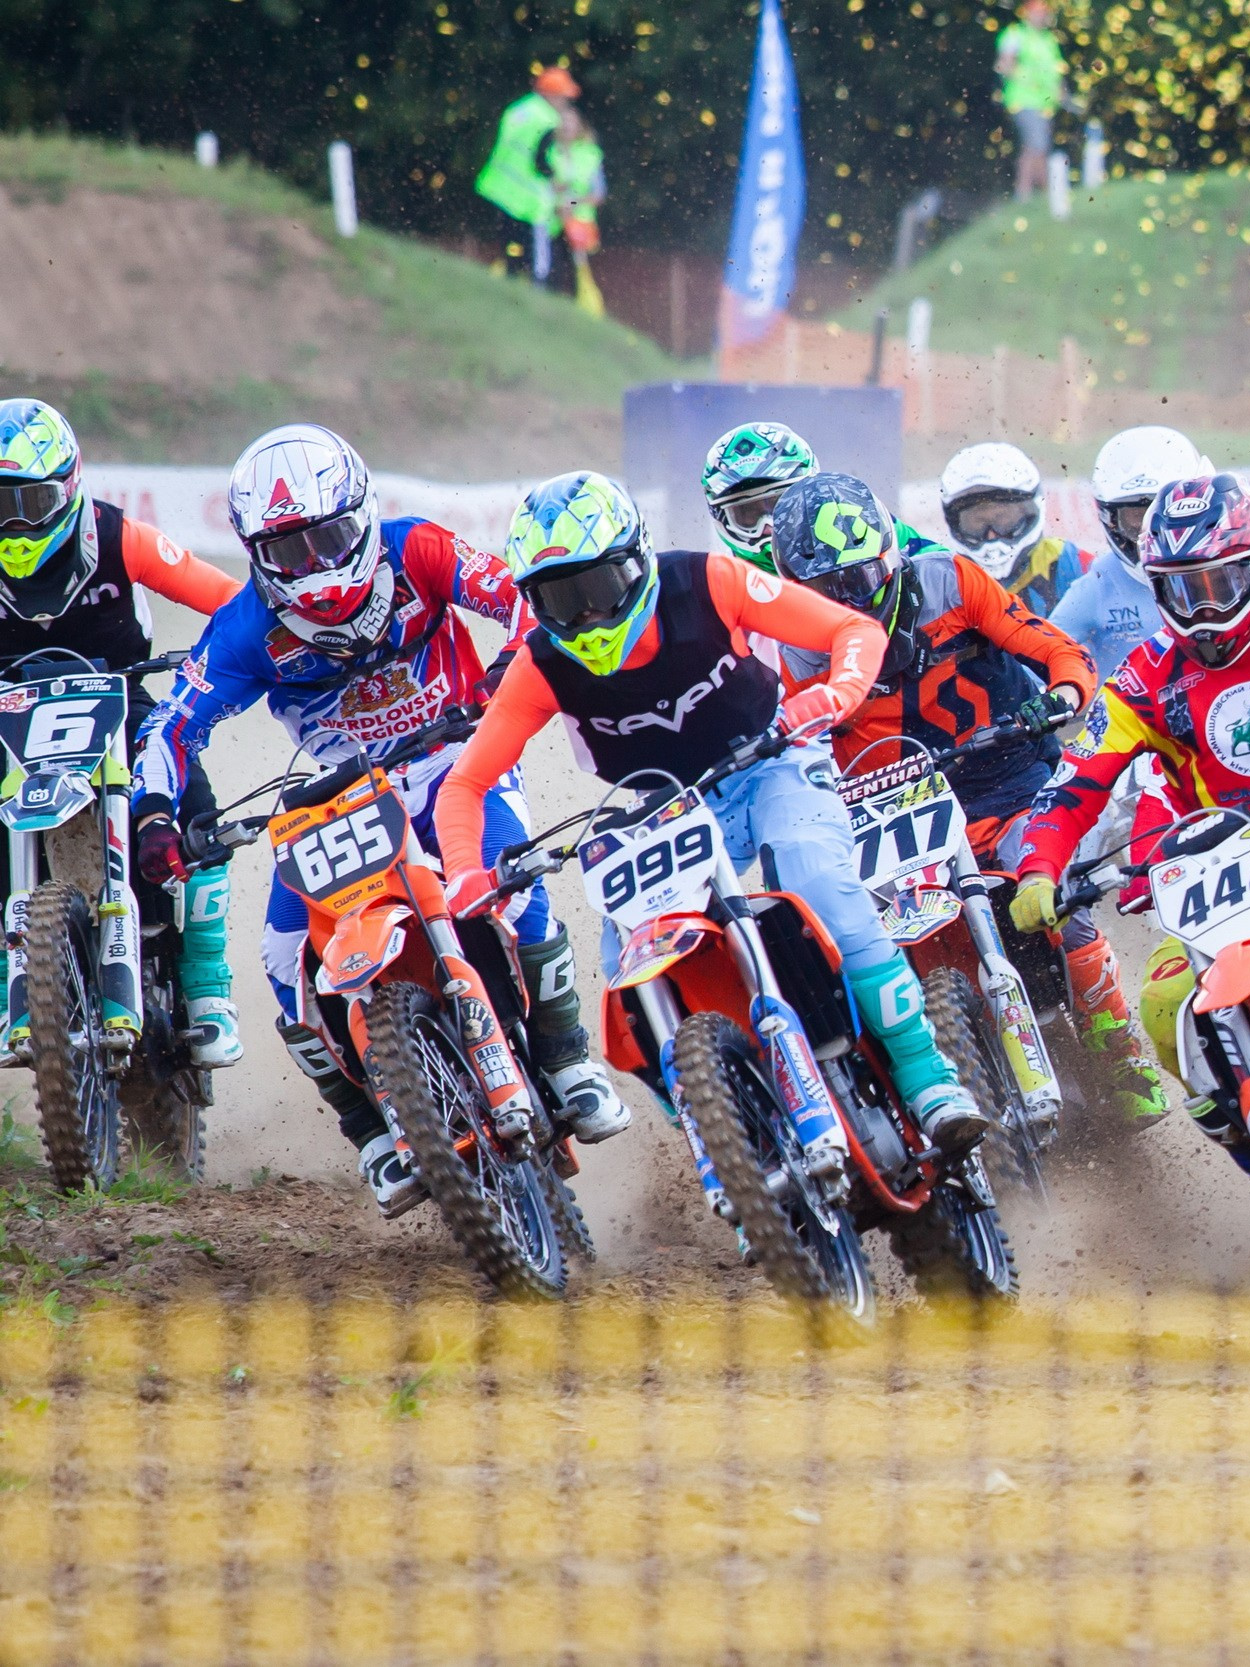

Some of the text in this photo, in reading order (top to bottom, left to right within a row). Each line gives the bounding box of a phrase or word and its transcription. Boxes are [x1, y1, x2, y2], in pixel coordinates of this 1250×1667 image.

[262, 498, 305, 520] 6D
[358, 593, 391, 642] 655
[315, 634, 350, 646] ORTEMA
[71, 679, 107, 687] PESTOV
[81, 684, 111, 692] ANTON
[23, 699, 101, 759] 6
[347, 713, 424, 742] REGION
[1208, 686, 1245, 761] КАМЫШЛОВСКИЙ
[275, 813, 311, 838] BALANDIN
[1177, 812, 1225, 844] KTM
[292, 804, 393, 893] 655
[854, 799, 953, 882] 717
[602, 823, 713, 914] 999
[886, 857, 930, 880] MURATOV
[113, 889, 124, 942] Husqna
[475, 1044, 506, 1060] RIDE
[484, 1067, 519, 1092] MX
